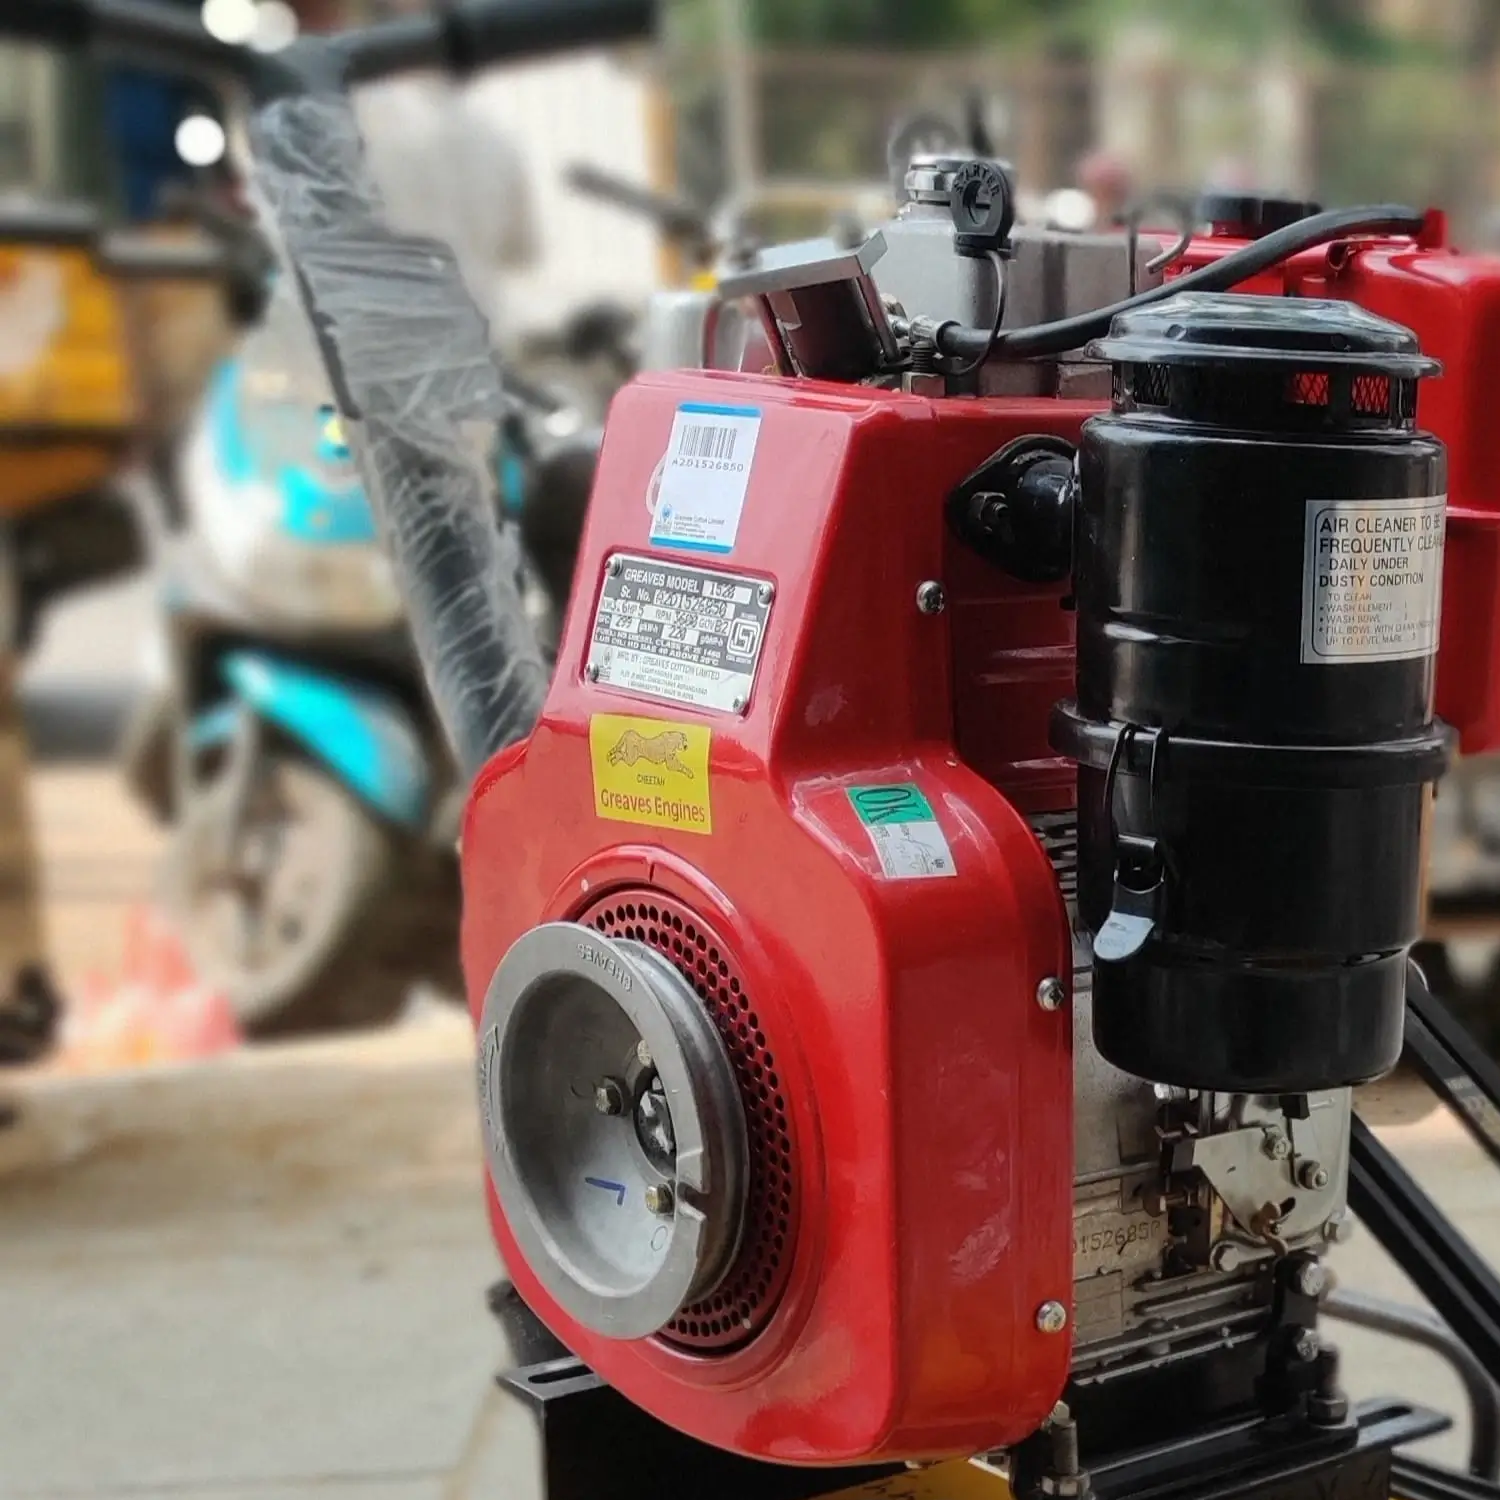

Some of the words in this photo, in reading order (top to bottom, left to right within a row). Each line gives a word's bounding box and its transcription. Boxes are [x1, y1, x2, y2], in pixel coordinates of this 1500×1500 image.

[1320, 517, 1349, 533] AIR
[1355, 515, 1417, 533] CLEANER
[1420, 514, 1432, 531] TO
[1319, 535, 1414, 554] FREQUENTLY
[1329, 557, 1368, 571] DAILY
[1373, 556, 1409, 571] UNDER
[624, 567, 666, 588] GREAVES
[666, 575, 700, 594] MODEL
[1319, 575, 1365, 588] DUSTY
[1370, 571, 1424, 588] CONDITION
[637, 588, 651, 602] No.
[1328, 591, 1341, 602] TO
[1344, 590, 1372, 602] CLEAN
[1326, 603, 1354, 613] WASH
[1326, 614, 1354, 624] WASH
[636, 773, 665, 786] CHEETAH
[600, 788, 652, 815] Greaves
[654, 796, 705, 823] Engines
[856, 787, 926, 824] OK
